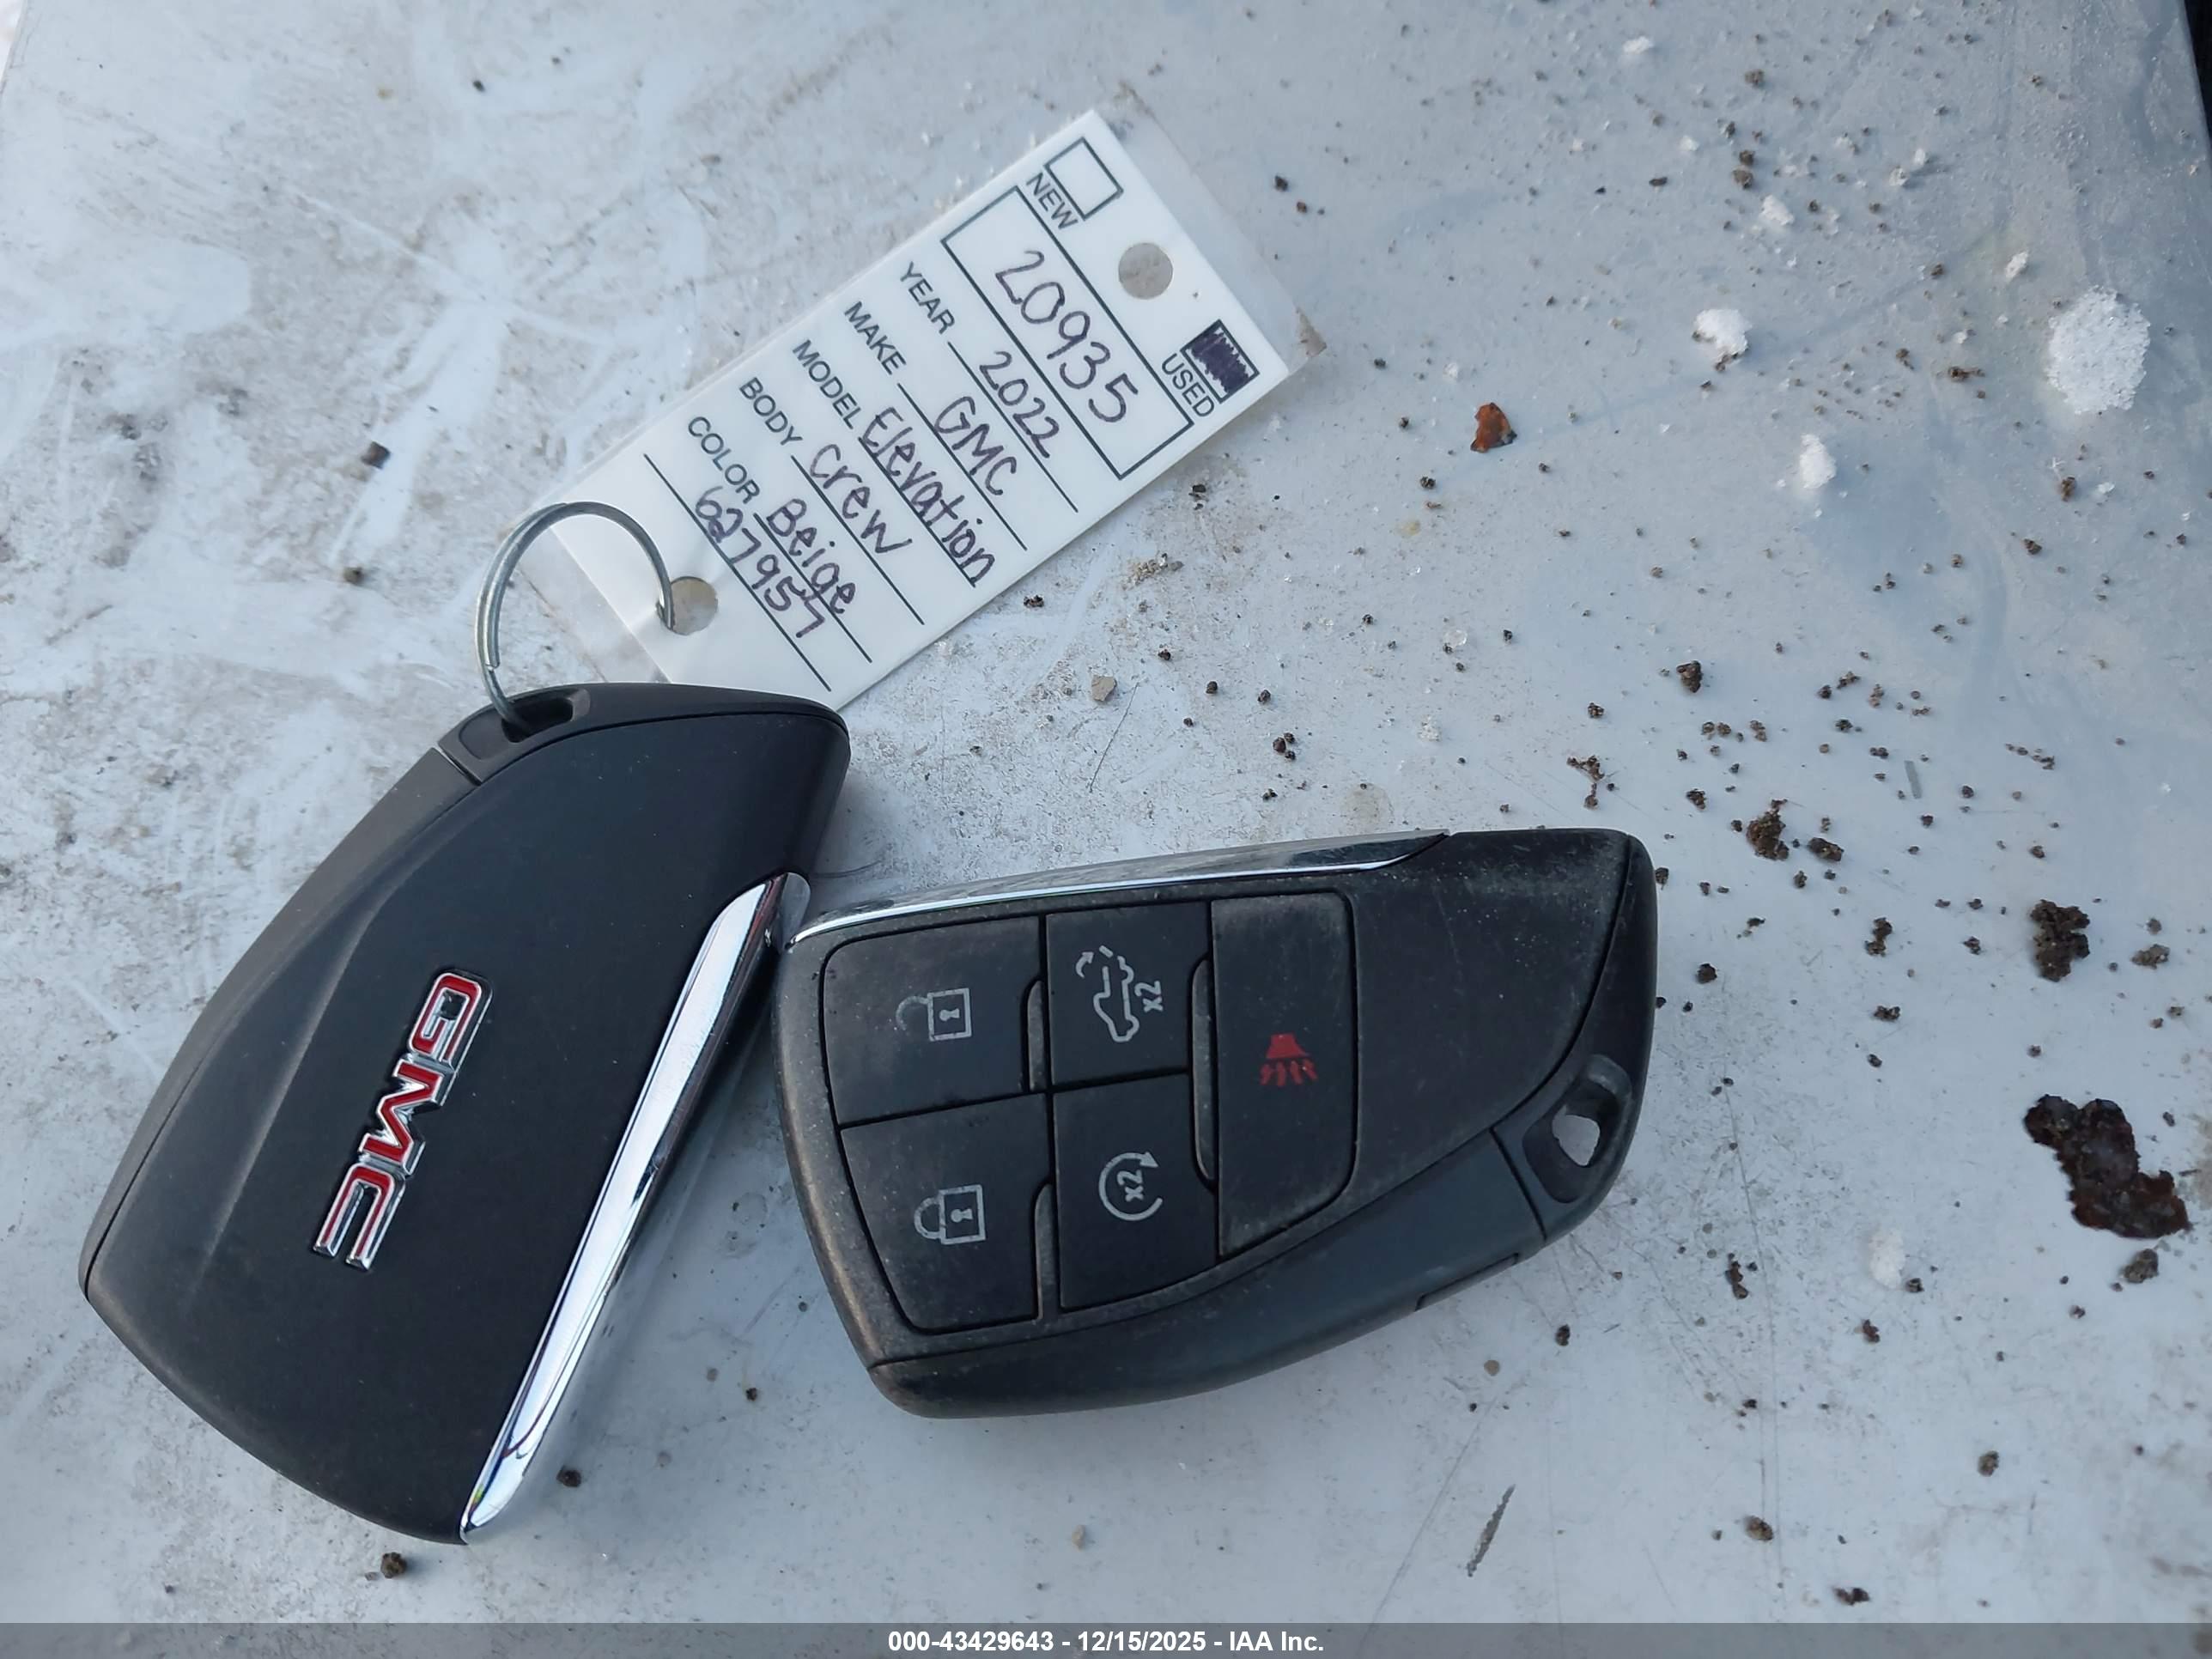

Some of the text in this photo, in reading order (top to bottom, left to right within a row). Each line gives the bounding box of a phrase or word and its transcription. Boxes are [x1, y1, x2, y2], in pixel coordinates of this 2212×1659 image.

[1027, 172, 1079, 229] NEW
[739, 377, 803, 447] BODY
[844, 301, 1024, 495] MAKE GMC
[900, 262, 1060, 459] YEAR 2022
[996, 251, 1139, 423] 20935
[1161, 353, 1215, 418] USED
[688, 416, 855, 614] COLOR Beige
[793, 339, 996, 586] MODEL Elevation
[696, 485, 825, 638] 627957
[313, 969, 492, 1271] GMC
